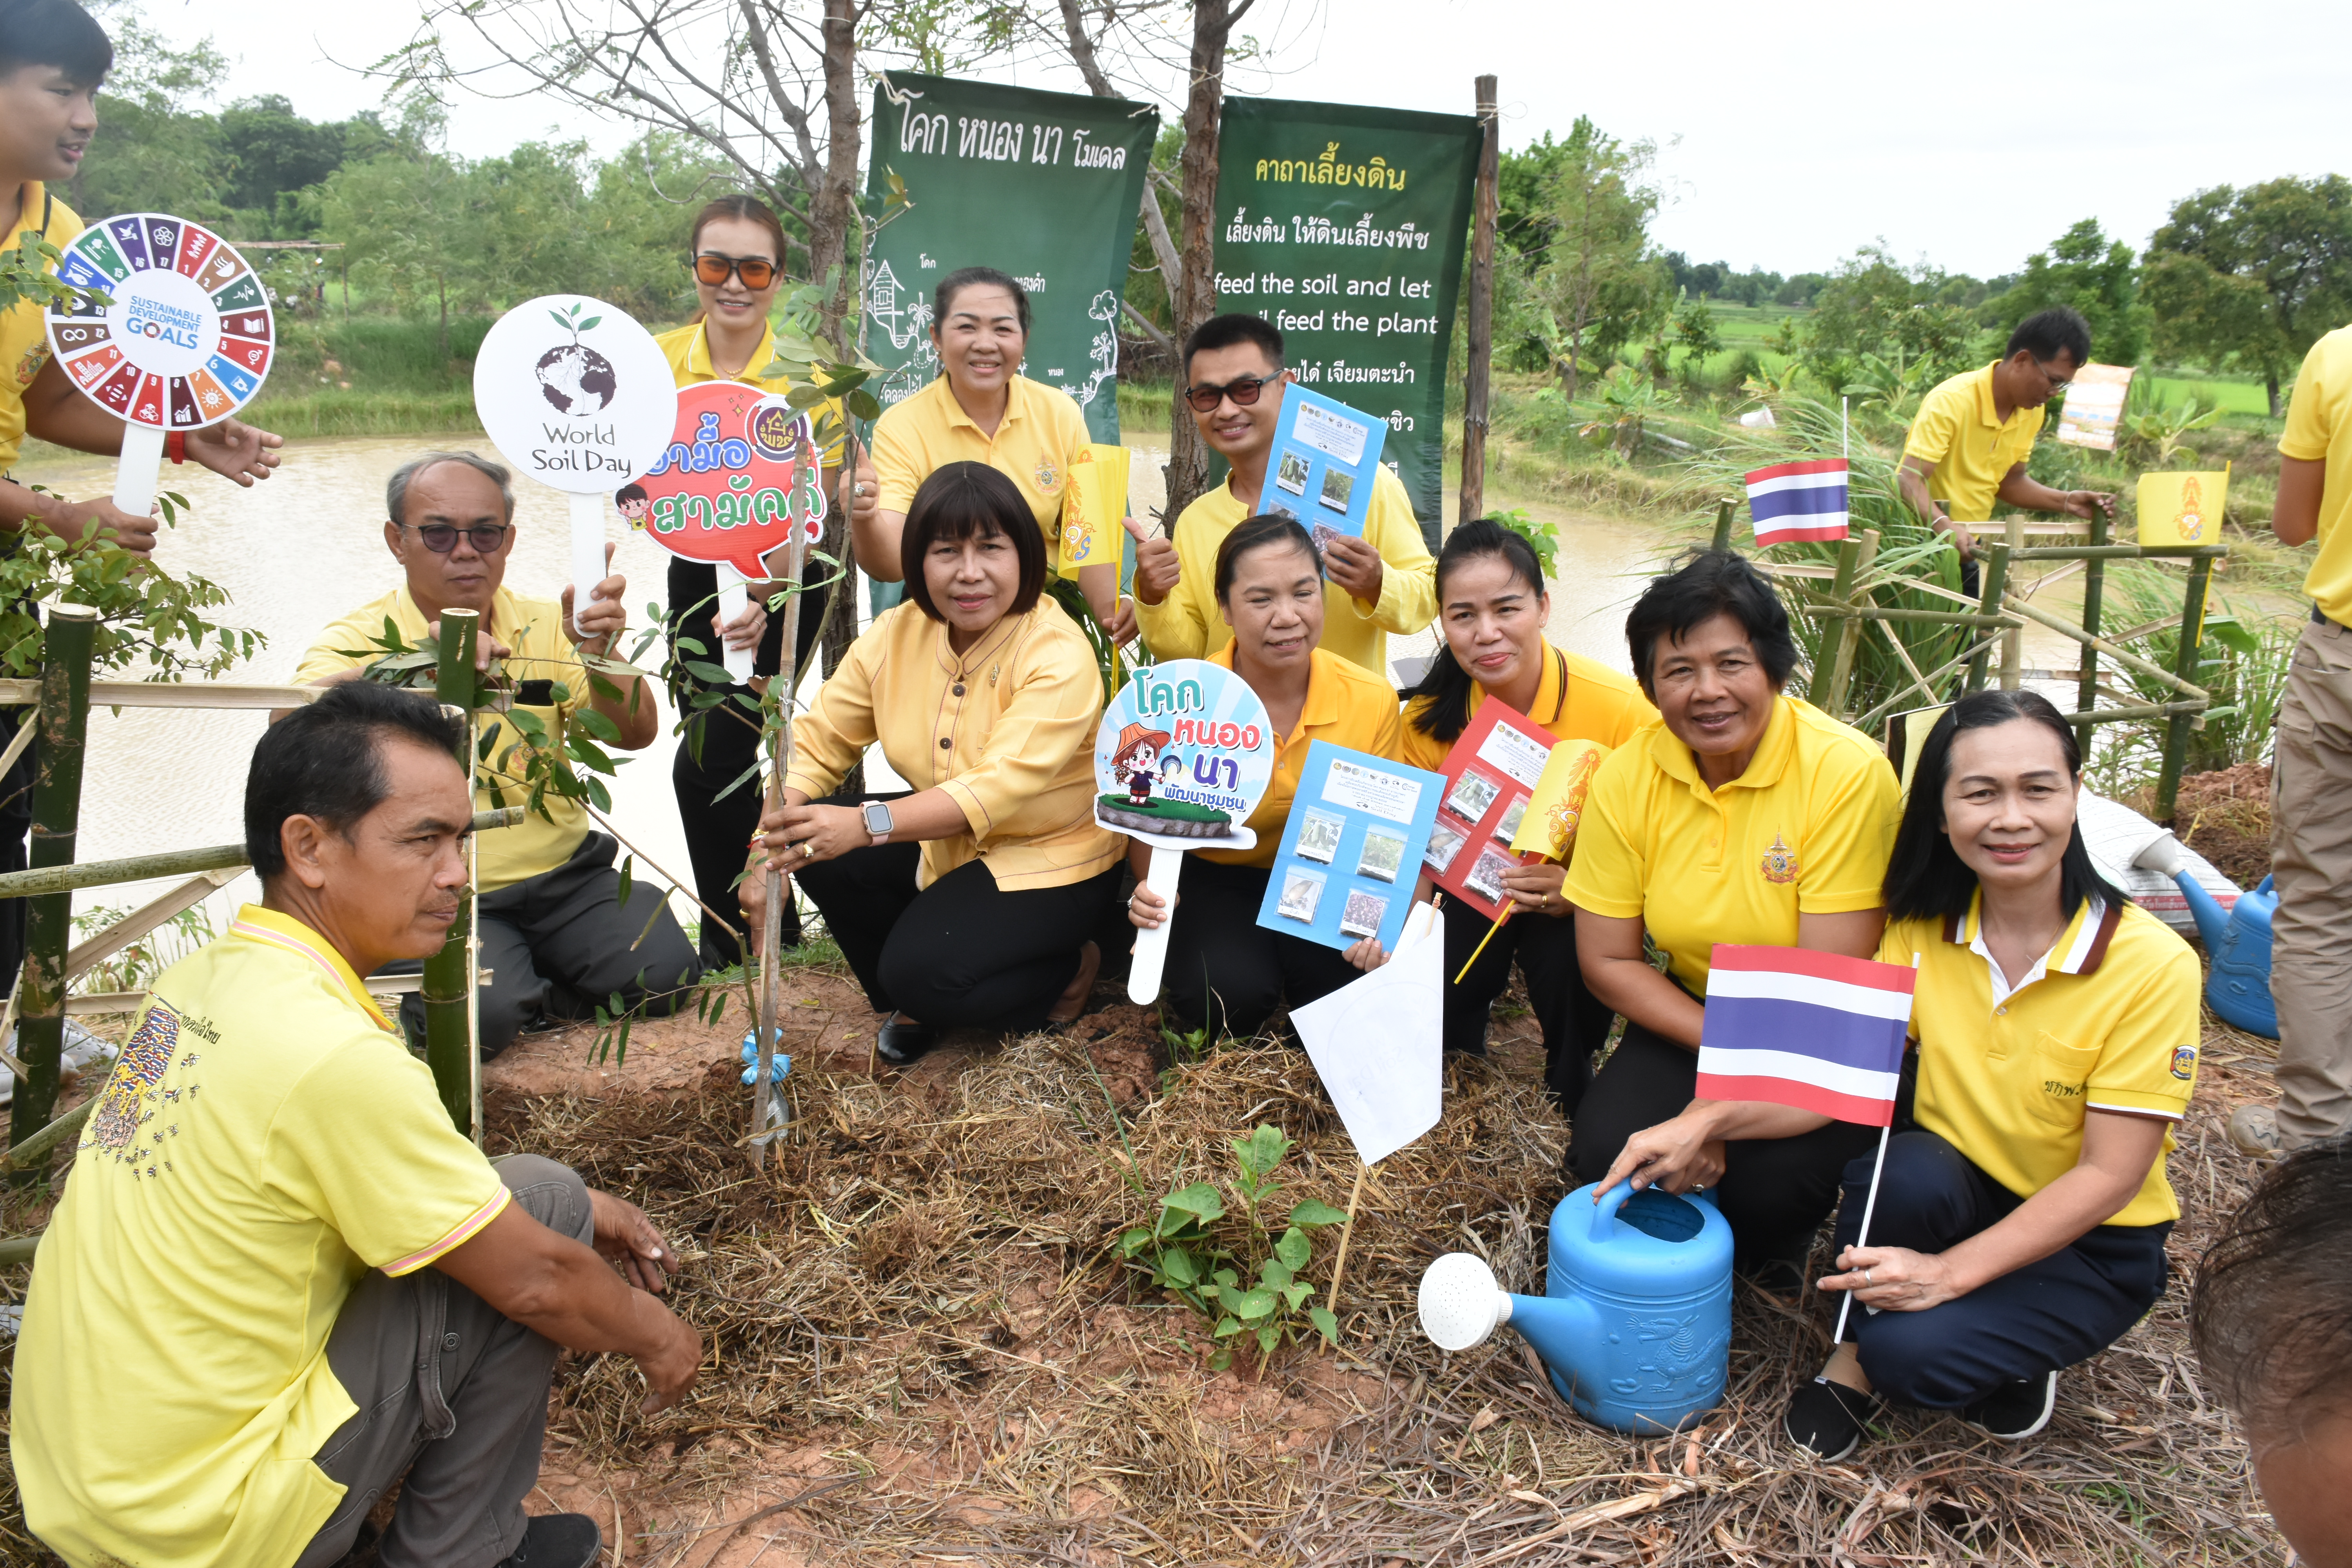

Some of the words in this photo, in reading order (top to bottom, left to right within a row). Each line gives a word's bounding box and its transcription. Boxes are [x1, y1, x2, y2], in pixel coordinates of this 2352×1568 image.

[900, 89, 949, 155] โคก
[959, 118, 1022, 162] หนอง
[1031, 125, 1062, 164] นา
[1074, 130, 1126, 169] โมเดล
[1256, 142, 1406, 191] คาถาเลี้ยงดิน
[1226, 207, 1285, 243] เลี้ยงดิน
[1293, 213, 1429, 250] ให้ดินเลี้ยงพืช
[136, 257, 144, 267] 16
[160, 257, 169, 267] 17
[919, 254, 936, 269] โคก
[114, 268, 123, 278] 15
[184, 265, 189, 273] 1
[203, 278, 210, 287] 2
[1214, 272, 1254, 294] feed
[1262, 274, 1294, 294] the
[1302, 274, 1338, 294] soil
[1347, 276, 1391, 296] and
[1400, 277, 1432, 299] let
[216, 297, 222, 306] 3
[95, 305, 104, 316] 13
[130, 296, 202, 322] SUSTAINABLE
[129, 305, 201, 332] DEVELOPMENT
[223, 320, 229, 329] 4
[1276, 310, 1323, 331] feed
[1332, 311, 1368, 332] the
[1377, 312, 1439, 337] plant
[96, 328, 104, 338] 12
[127, 318, 198, 350] GOALS
[221, 341, 227, 350] 5
[109, 349, 118, 359] 11
[210, 359, 218, 368] 6
[126, 367, 136, 376] 10
[194, 372, 200, 381] 7
[1328, 360, 1414, 383] เจียมตะนำ
[151, 377, 156, 386] 9
[172, 379, 180, 387] 8
[542, 423, 615, 446] World
[532, 450, 584, 470] Soil
[586, 450, 632, 479] Day
[1133, 669, 1201, 715] โคก
[1174, 719, 1260, 749] หนอง
[1194, 754, 1238, 789] นา
[1164, 783, 1245, 811] พัฒนาชุมชน
